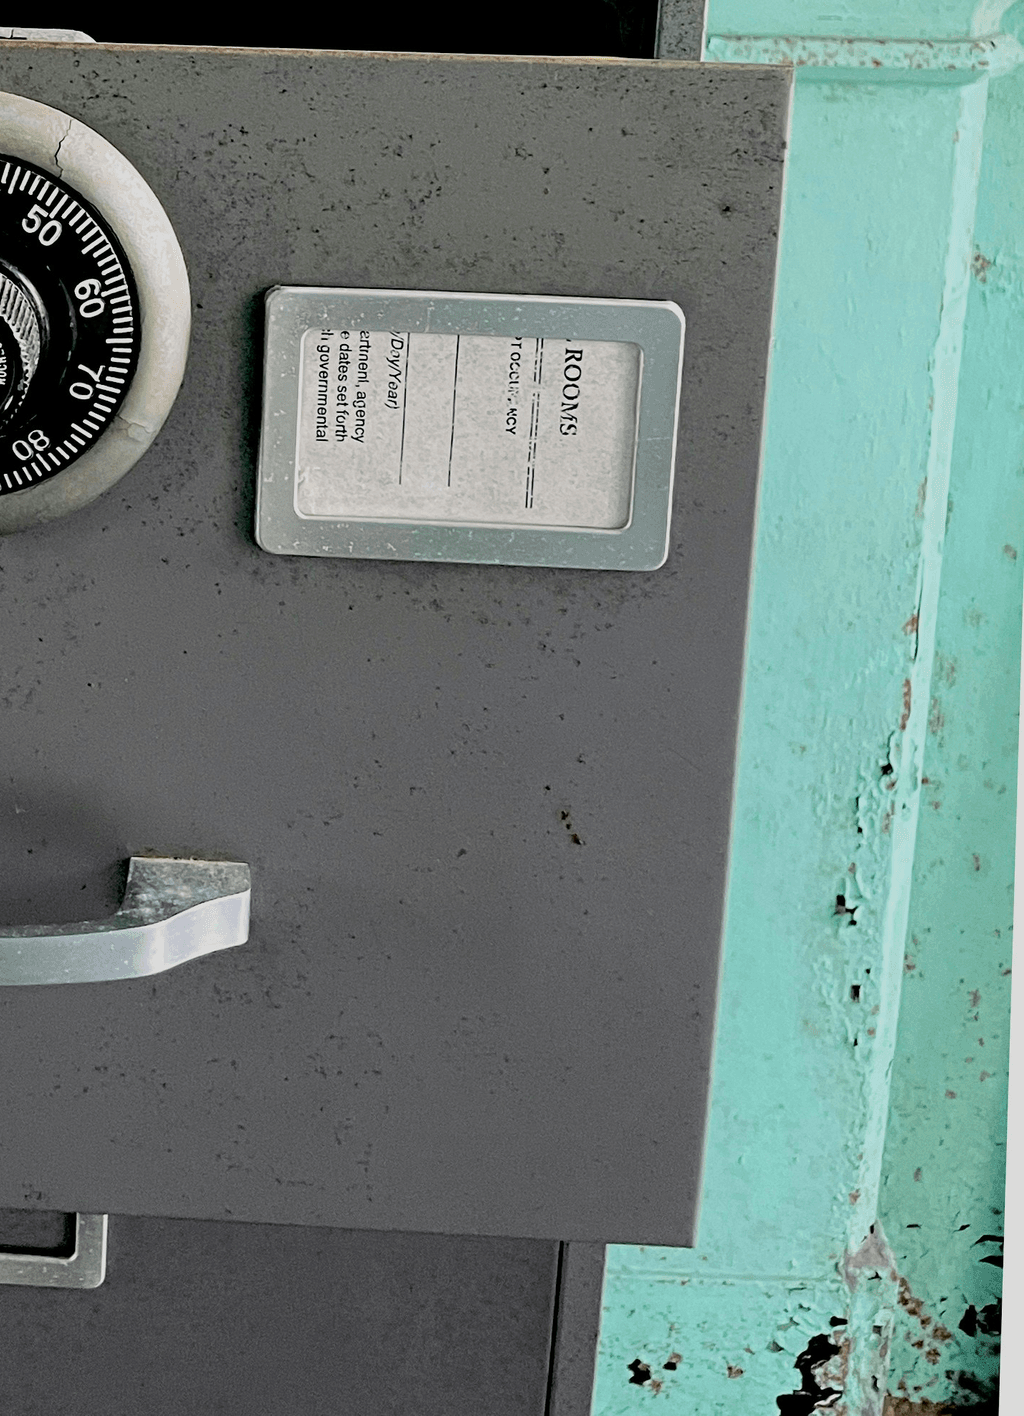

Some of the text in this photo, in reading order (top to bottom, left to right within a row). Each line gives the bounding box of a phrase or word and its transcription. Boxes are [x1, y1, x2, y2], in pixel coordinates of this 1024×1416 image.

[21, 205, 63, 246] 50
[74, 278, 105, 318] 60
[69, 364, 105, 400] 70
[338, 343, 353, 382] dates
[384, 331, 405, 410] /Day/Year)
[316, 344, 330, 442] governmental
[336, 385, 349, 407] set
[506, 352, 521, 435] OCCUNCY
[559, 347, 583, 436] ROOMS
[335, 409, 350, 442] forth
[351, 391, 367, 443] agency
[12, 429, 51, 461] 80
